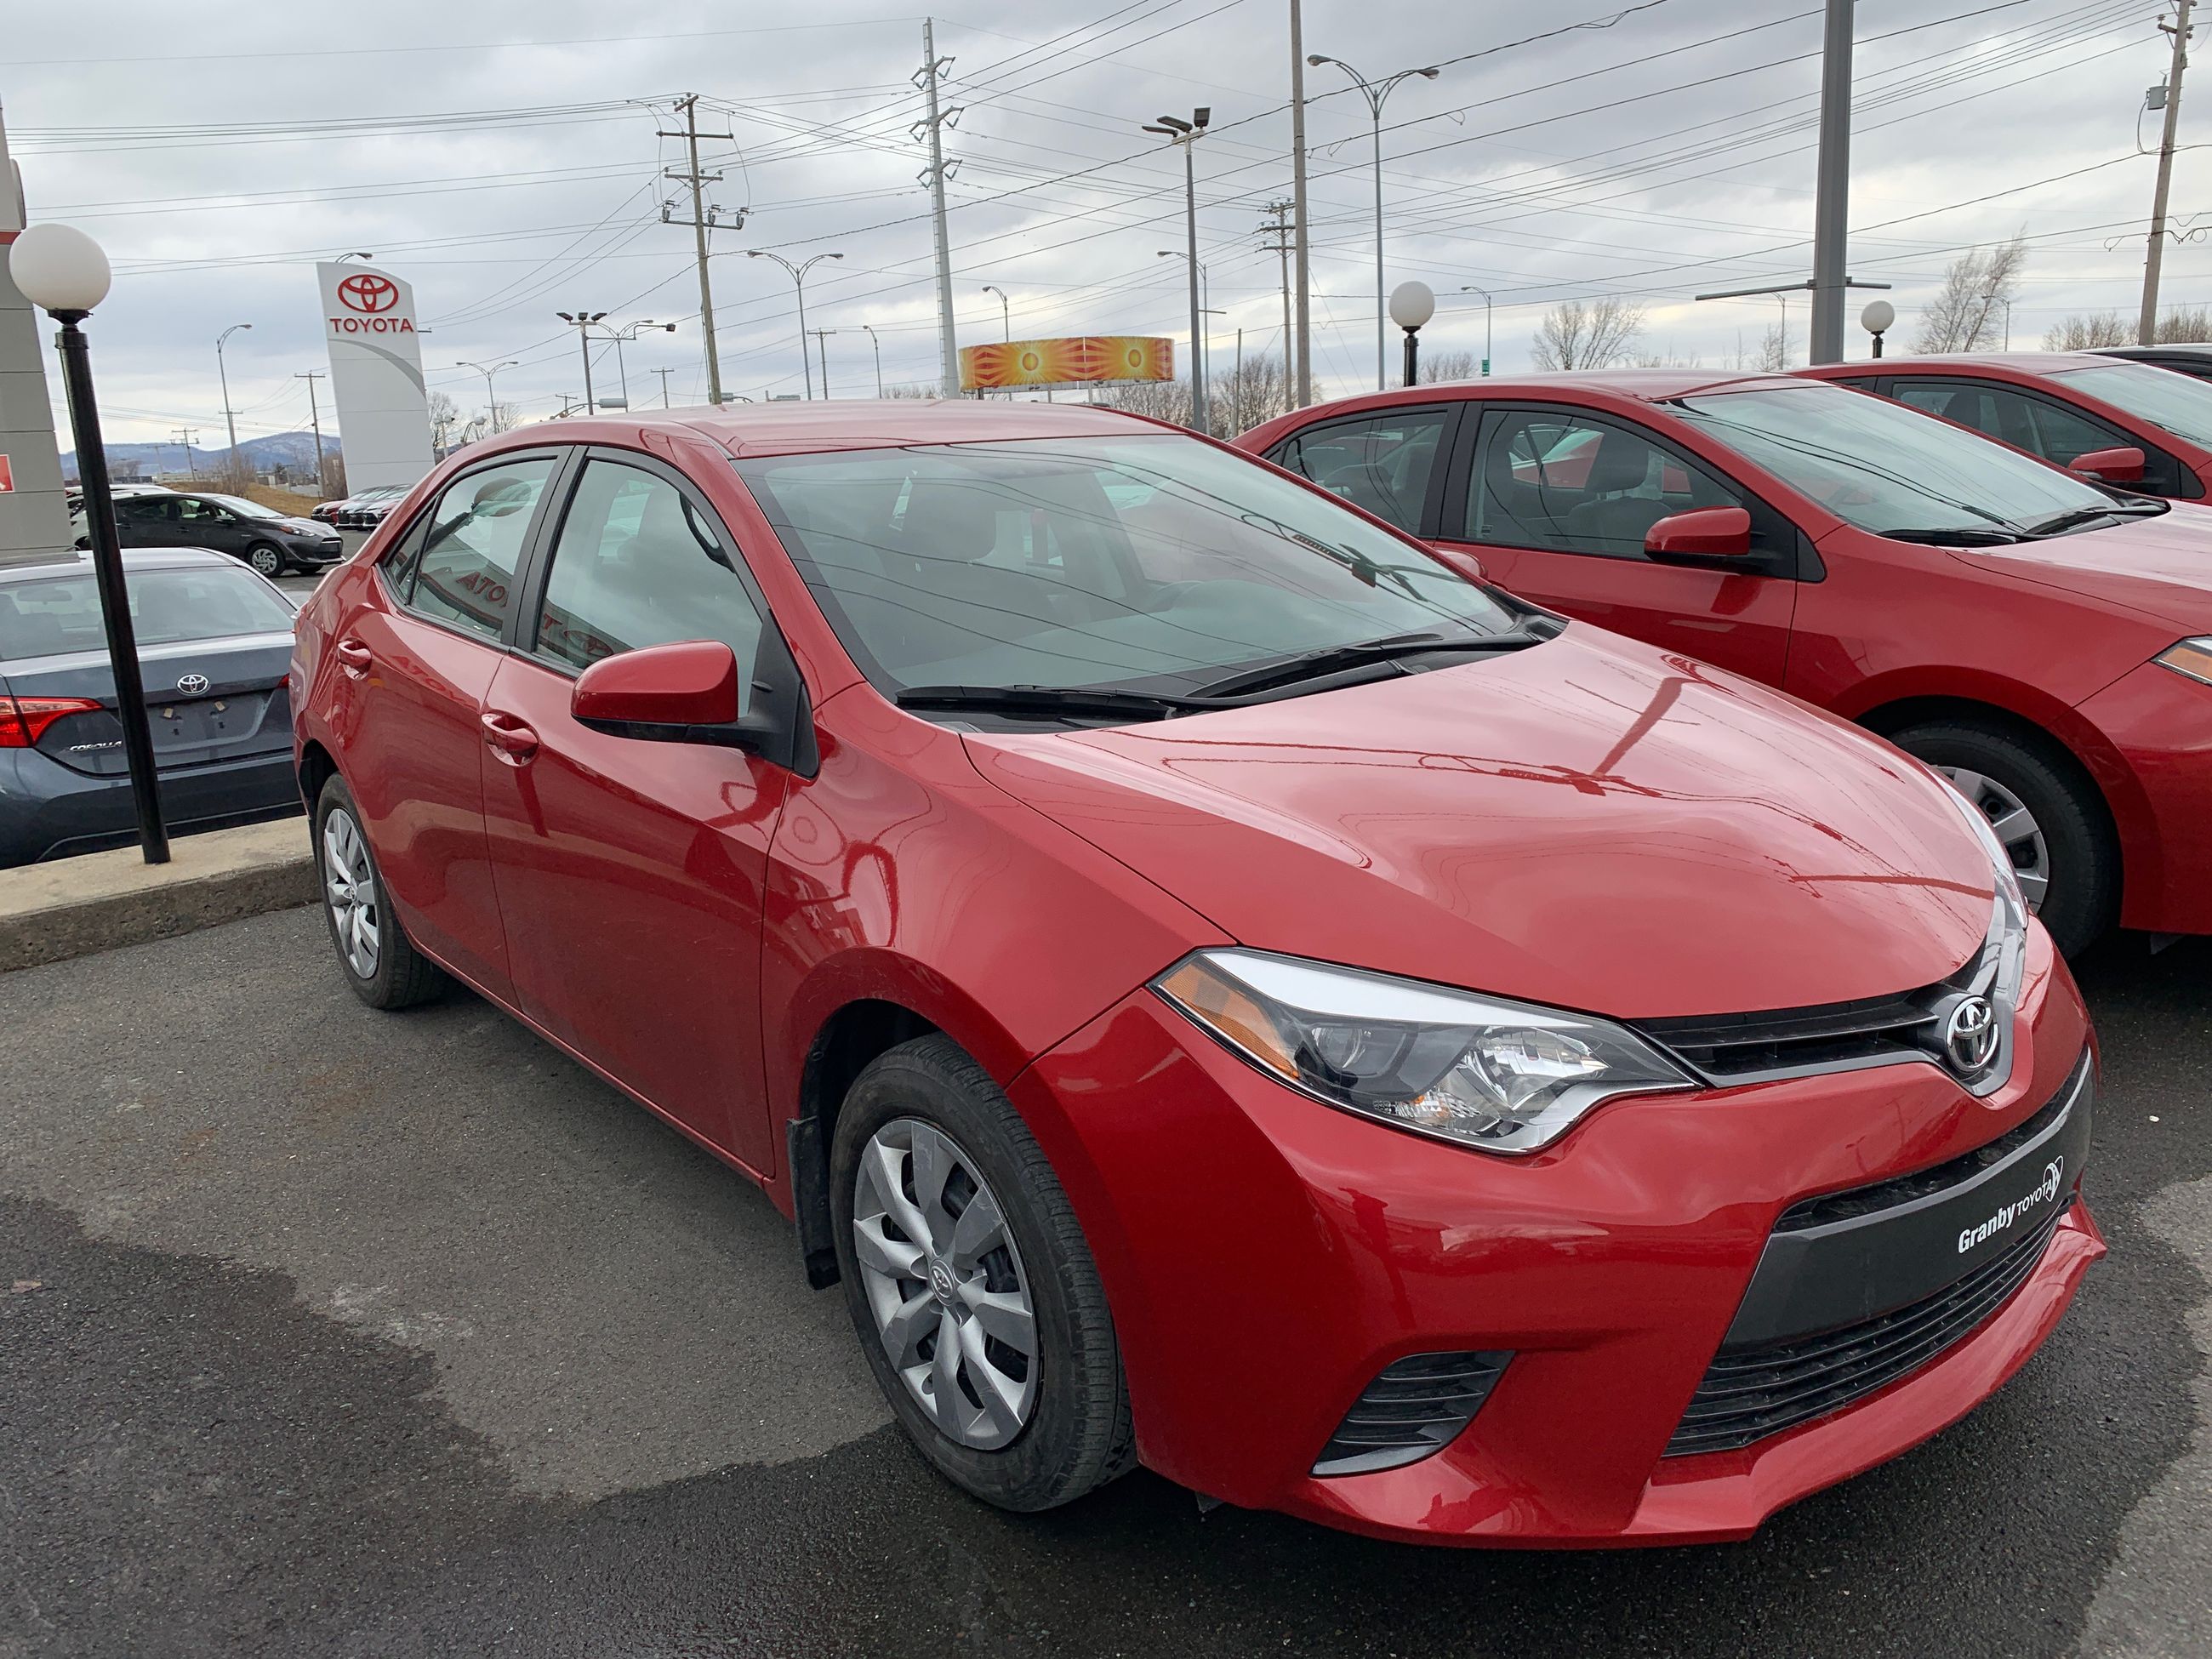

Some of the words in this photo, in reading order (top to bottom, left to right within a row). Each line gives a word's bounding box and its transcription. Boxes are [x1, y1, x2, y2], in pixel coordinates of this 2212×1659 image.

[329, 317, 414, 333] TOYOTA
[69, 740, 123, 752] COROLLA
[1958, 1202, 2016, 1254] Granby
[2016, 1178, 2053, 1217] TOYOTA
